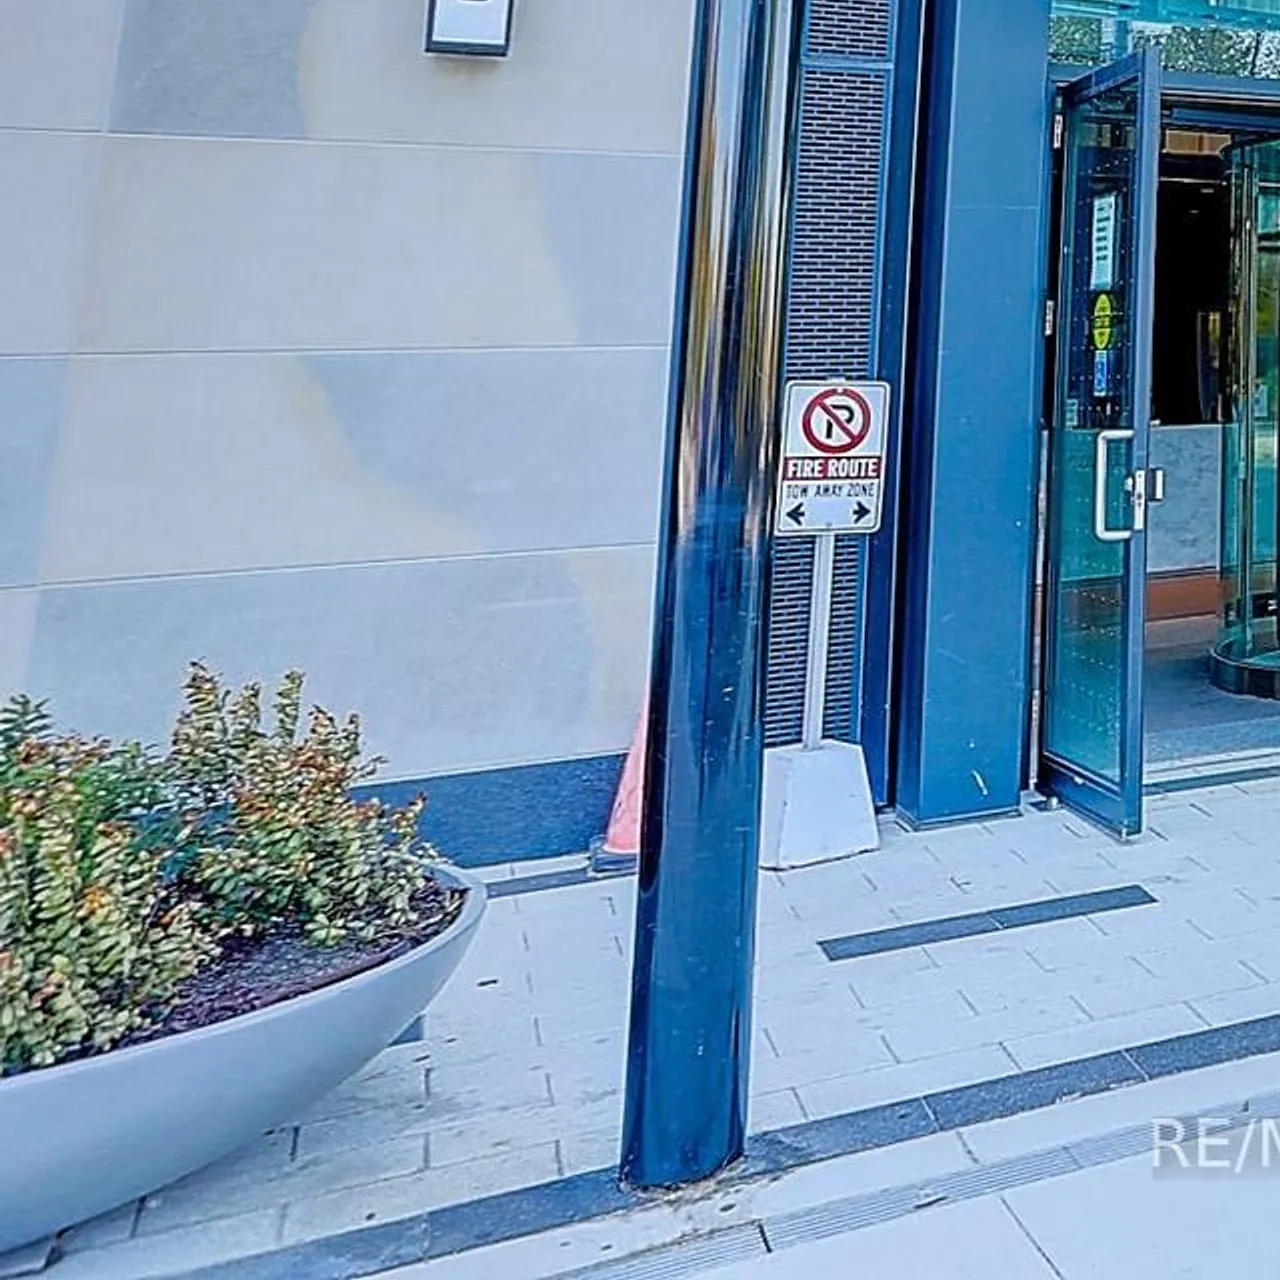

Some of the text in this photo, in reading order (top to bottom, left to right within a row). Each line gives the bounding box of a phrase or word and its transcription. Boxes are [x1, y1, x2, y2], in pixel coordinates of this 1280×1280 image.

[786, 458, 879, 479] FIRE ROUTE
[786, 482, 875, 499] TOW AWAY ZONE
